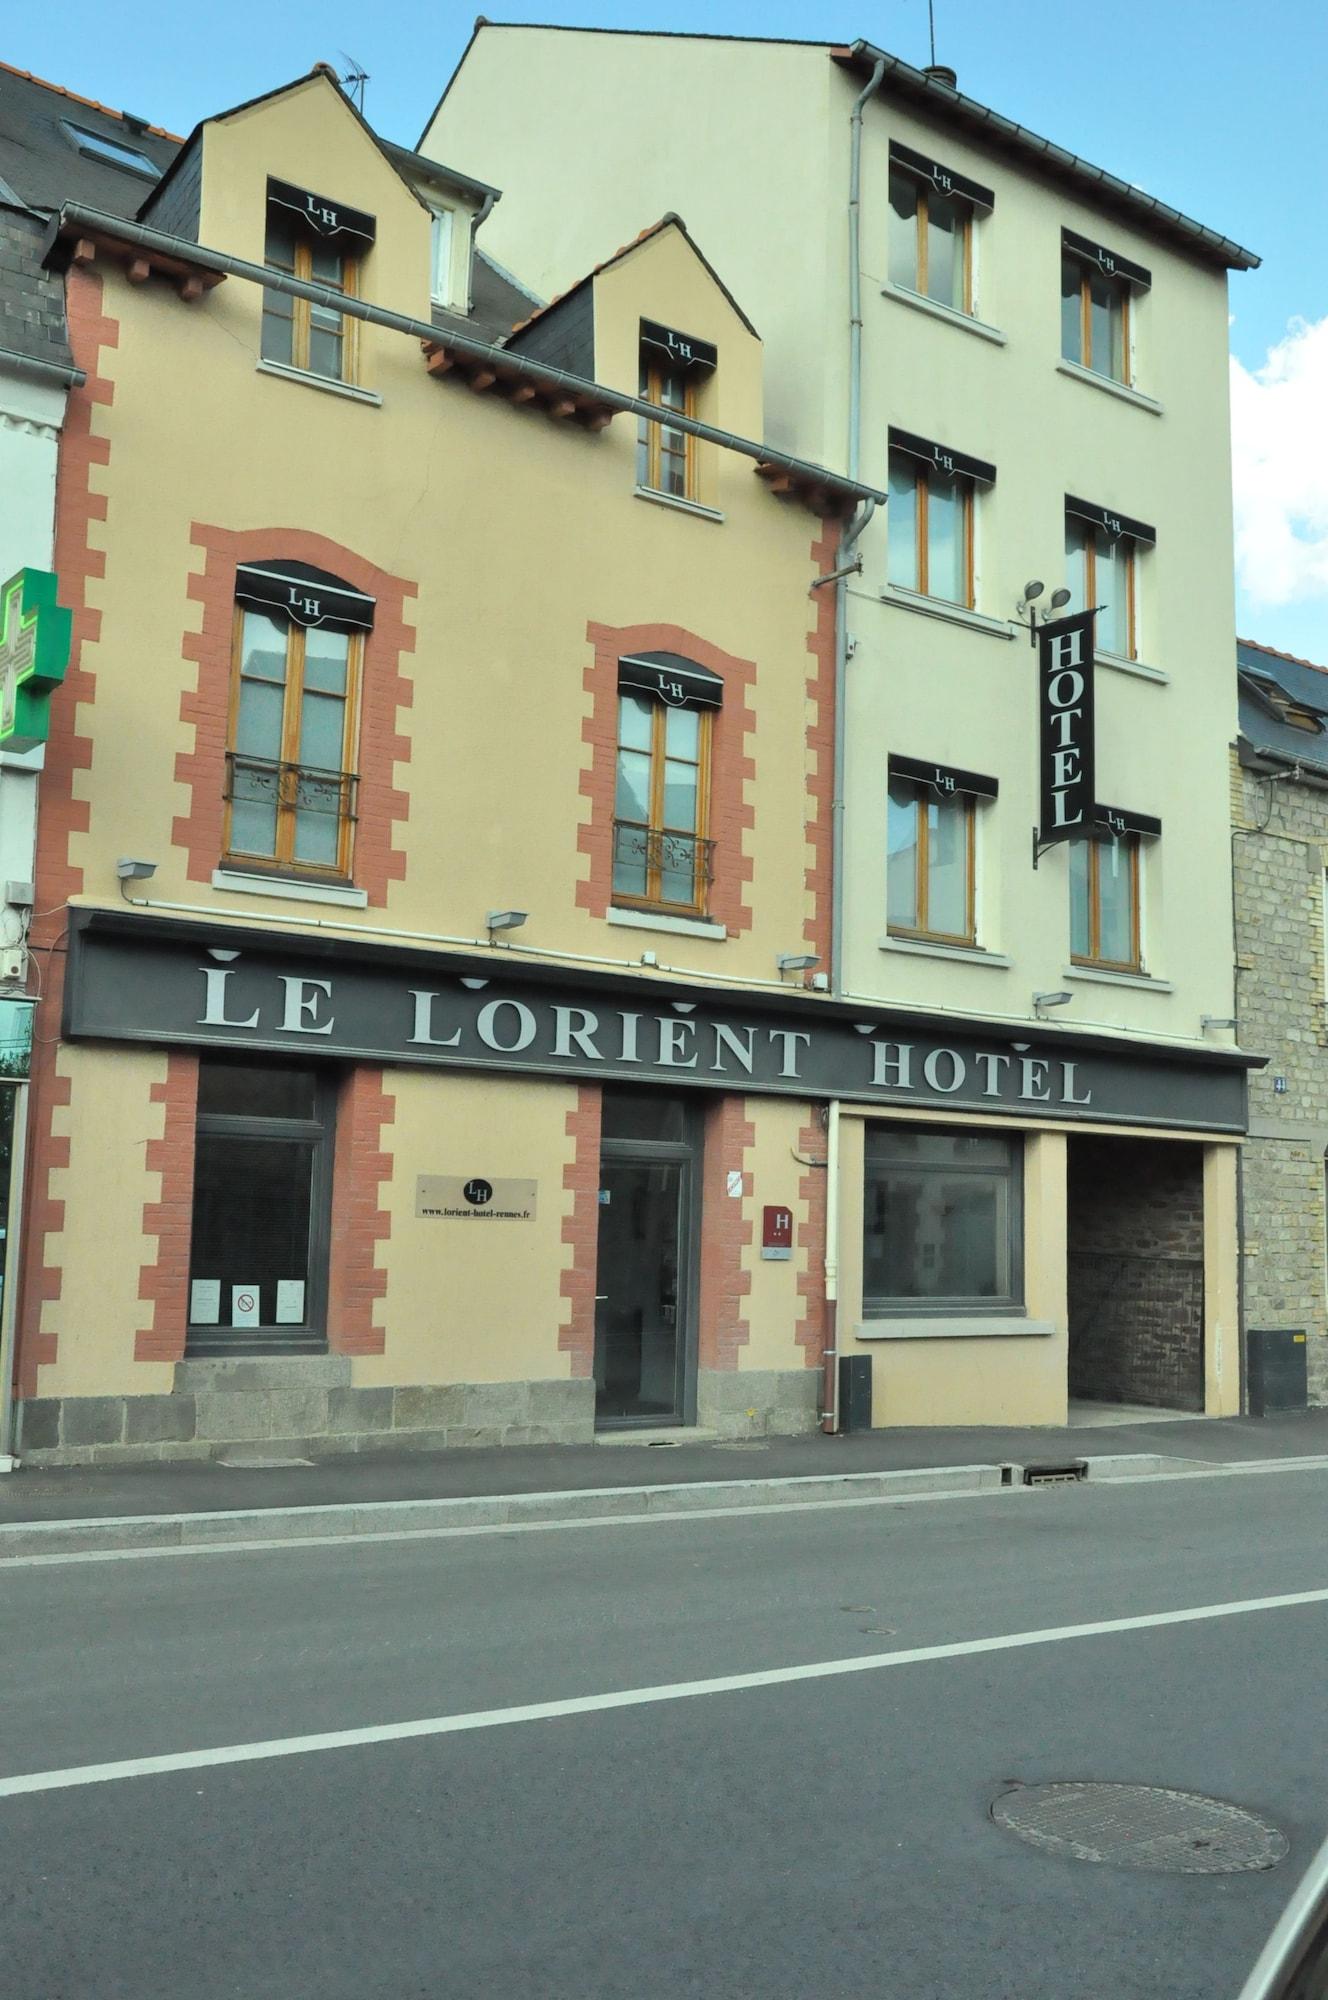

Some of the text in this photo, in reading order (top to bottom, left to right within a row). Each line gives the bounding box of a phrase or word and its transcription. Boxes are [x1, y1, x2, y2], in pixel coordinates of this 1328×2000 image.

[933, 165, 952, 190] LH
[307, 196, 338, 227] LH
[1098, 249, 1115, 272] LH
[667, 332, 692, 359] LH
[933, 447, 953, 471] LH
[1103, 512, 1121, 533] LH
[288, 587, 321, 617] LH
[658, 674, 684, 699] LH
[1048, 629, 1084, 828] HOTEL
[935, 769, 955, 791] LH
[1108, 811, 1126, 831] LH
[196, 967, 1091, 1104] LE LORIENT HOTEL
[468, 1182, 488, 1202] LH
[422, 1207, 530, 1219] www.lorient-hotel-rennes.fr
[776, 1214, 788, 1229] H
